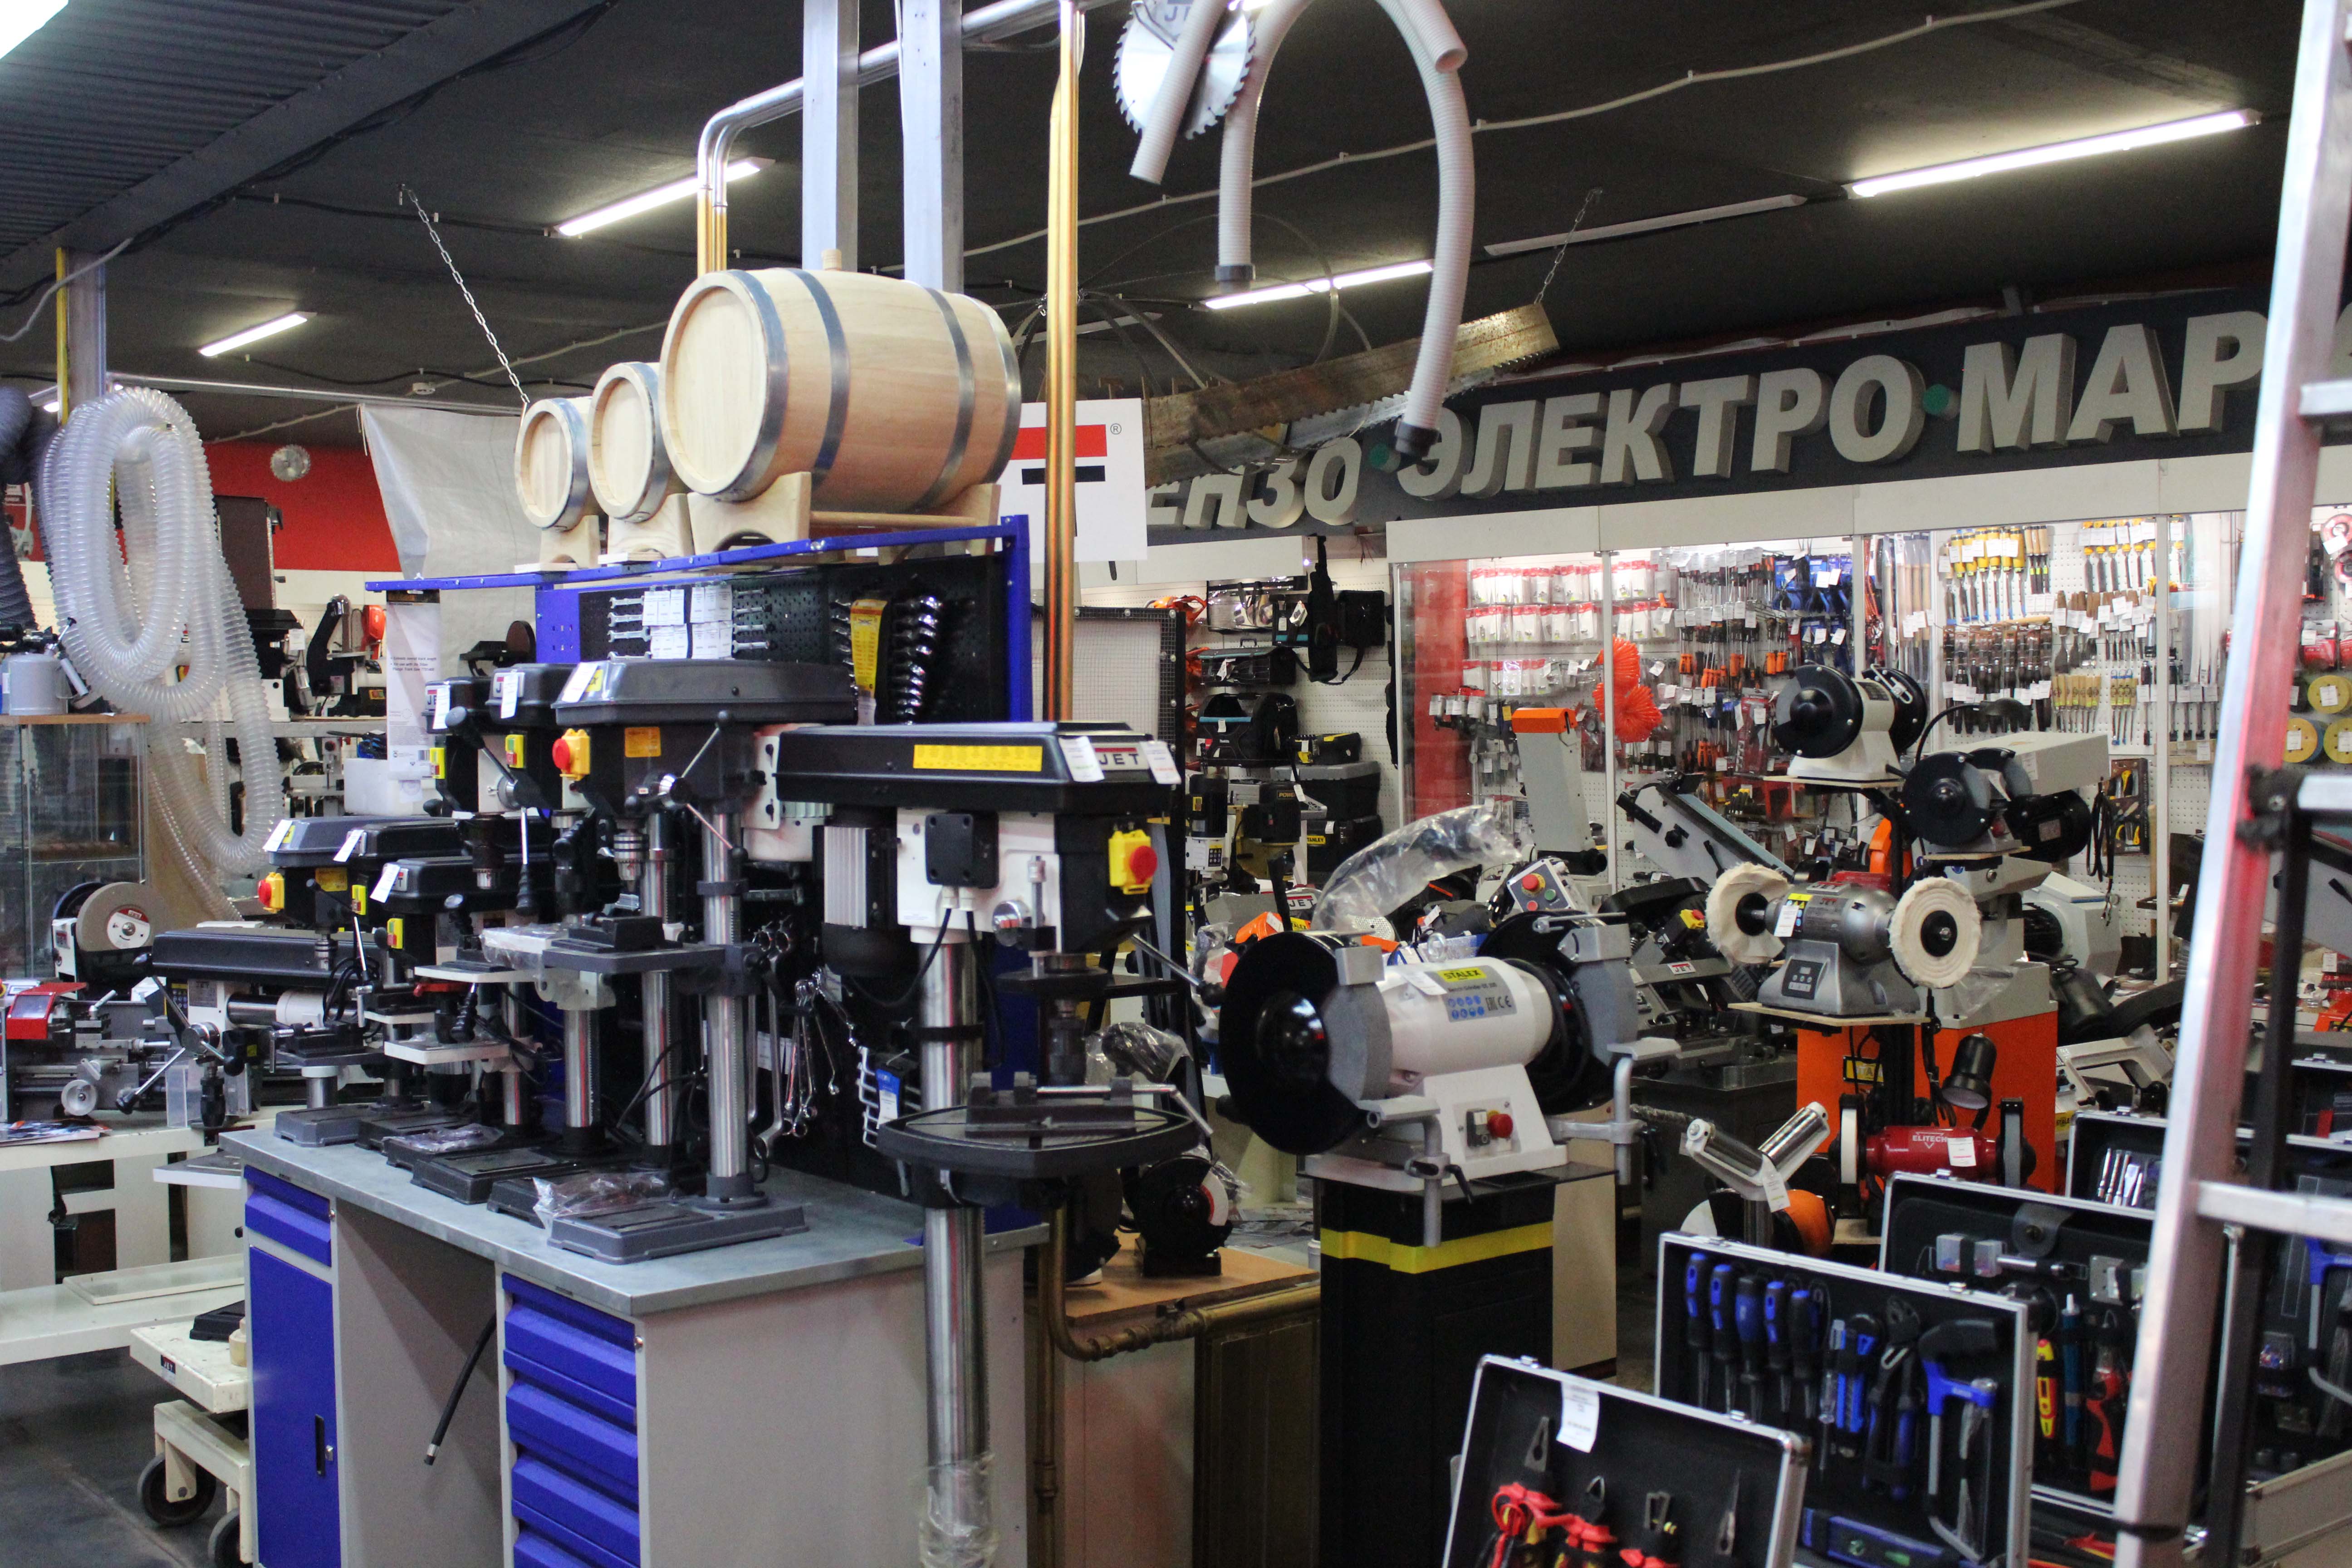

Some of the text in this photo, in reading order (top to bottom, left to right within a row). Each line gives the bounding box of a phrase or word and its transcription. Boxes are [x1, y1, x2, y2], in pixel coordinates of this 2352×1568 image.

[1146, 438, 1362, 529] ЕНЗО
[1397, 355, 1920, 500] ЭЛЕКТРО
[1958, 309, 2352, 453] МАР
[427, 695, 436, 705] JE
[1099, 753, 1140, 766] JET
[1289, 898, 1313, 907] JET
[1444, 970, 1480, 979] STALEX
[2057, 1117, 2070, 1126] STALE
[164, 1361, 174, 1372] JET
